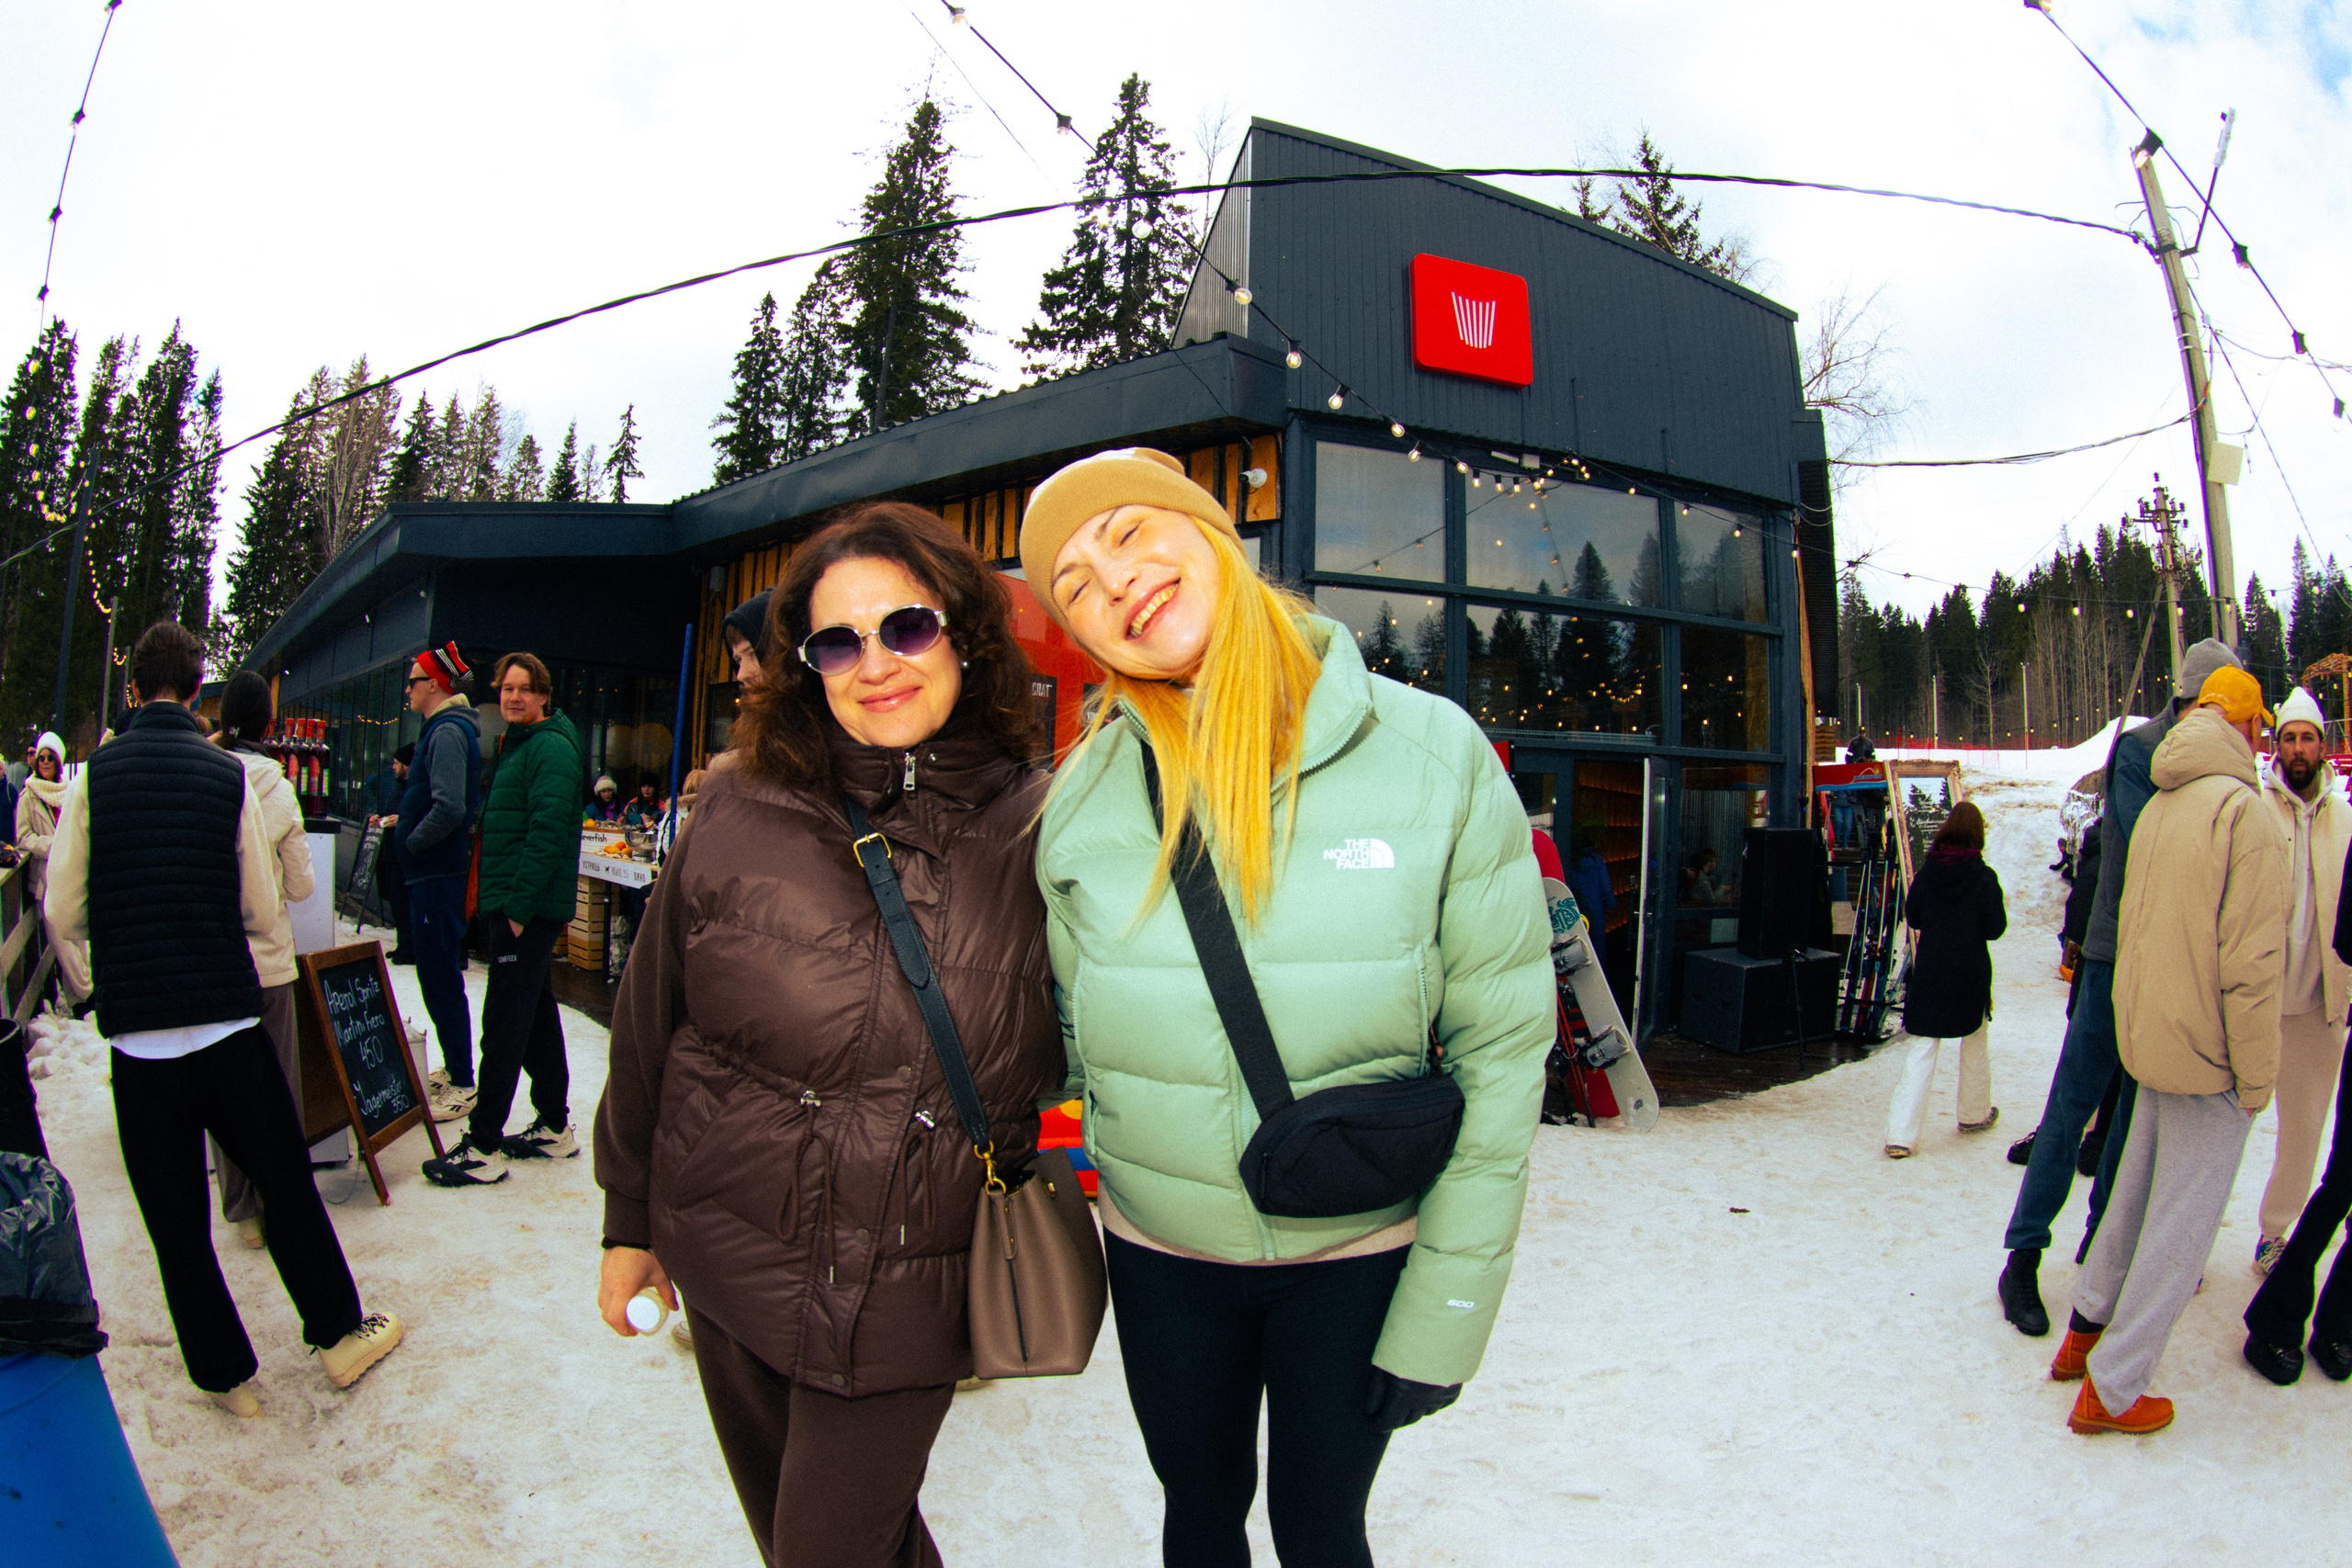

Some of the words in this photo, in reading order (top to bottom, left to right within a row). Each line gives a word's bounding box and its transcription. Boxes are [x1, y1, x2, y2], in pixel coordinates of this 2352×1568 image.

[1344, 838, 1370, 849] THE
[1323, 849, 1370, 860] NORTH
[1336, 859, 1370, 870] FACE
[355, 974, 380, 1009] Spritz
[334, 1016, 366, 1047] Martini
[363, 1011, 385, 1032] Fiero
[359, 1035, 383, 1068] 450
[390, 1094, 410, 1113] 350
